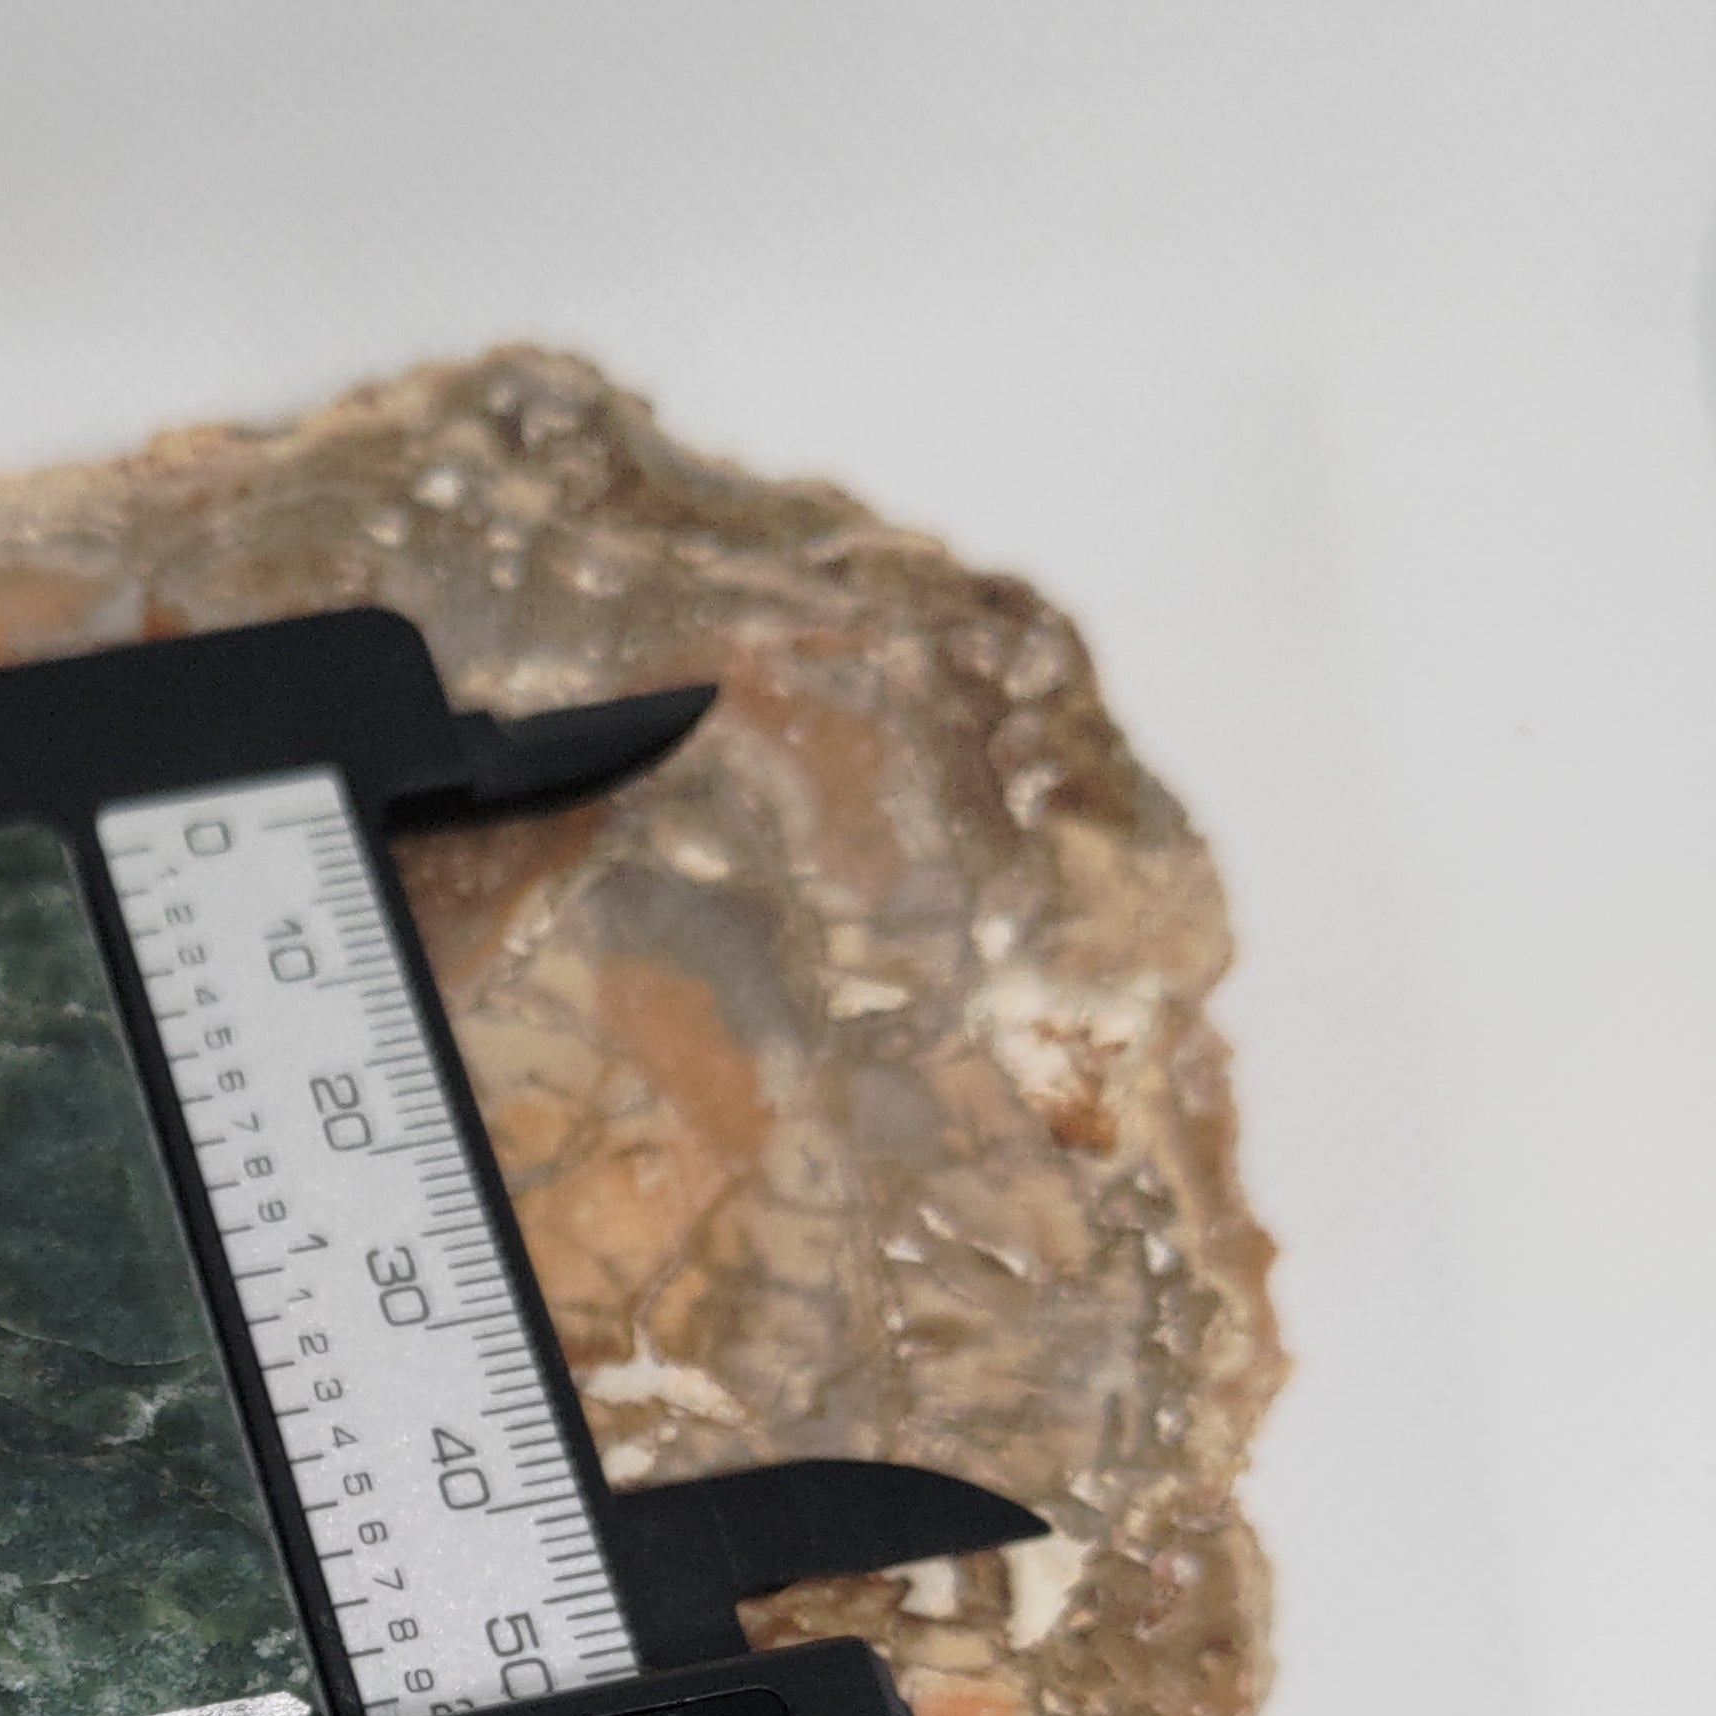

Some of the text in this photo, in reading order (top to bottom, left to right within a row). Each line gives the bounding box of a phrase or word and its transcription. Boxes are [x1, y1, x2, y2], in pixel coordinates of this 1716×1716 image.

[165, 904, 193, 923] 2
[177, 944, 206, 965] 3
[194, 986, 218, 1006] 4
[204, 1026, 232, 1049] 5
[217, 1069, 246, 1092] 6
[232, 1112, 260, 1133] 7
[244, 1155, 273, 1178] 8
[258, 1200, 287, 1224] 9
[288, 1233, 329, 1254] 1
[184, 820, 553, 1700] 0 10 20 30 40 50
[288, 1288, 313, 1304] 1
[298, 1332, 329, 1356] 2
[313, 1378, 344, 1402] 3
[330, 1425, 358, 1449] 4
[342, 1471, 373, 1496] 5
[358, 1520, 389, 1545] 6
[373, 1568, 405, 1592] 7
[387, 1618, 419, 1643] 8
[403, 1668, 435, 1694] 9
